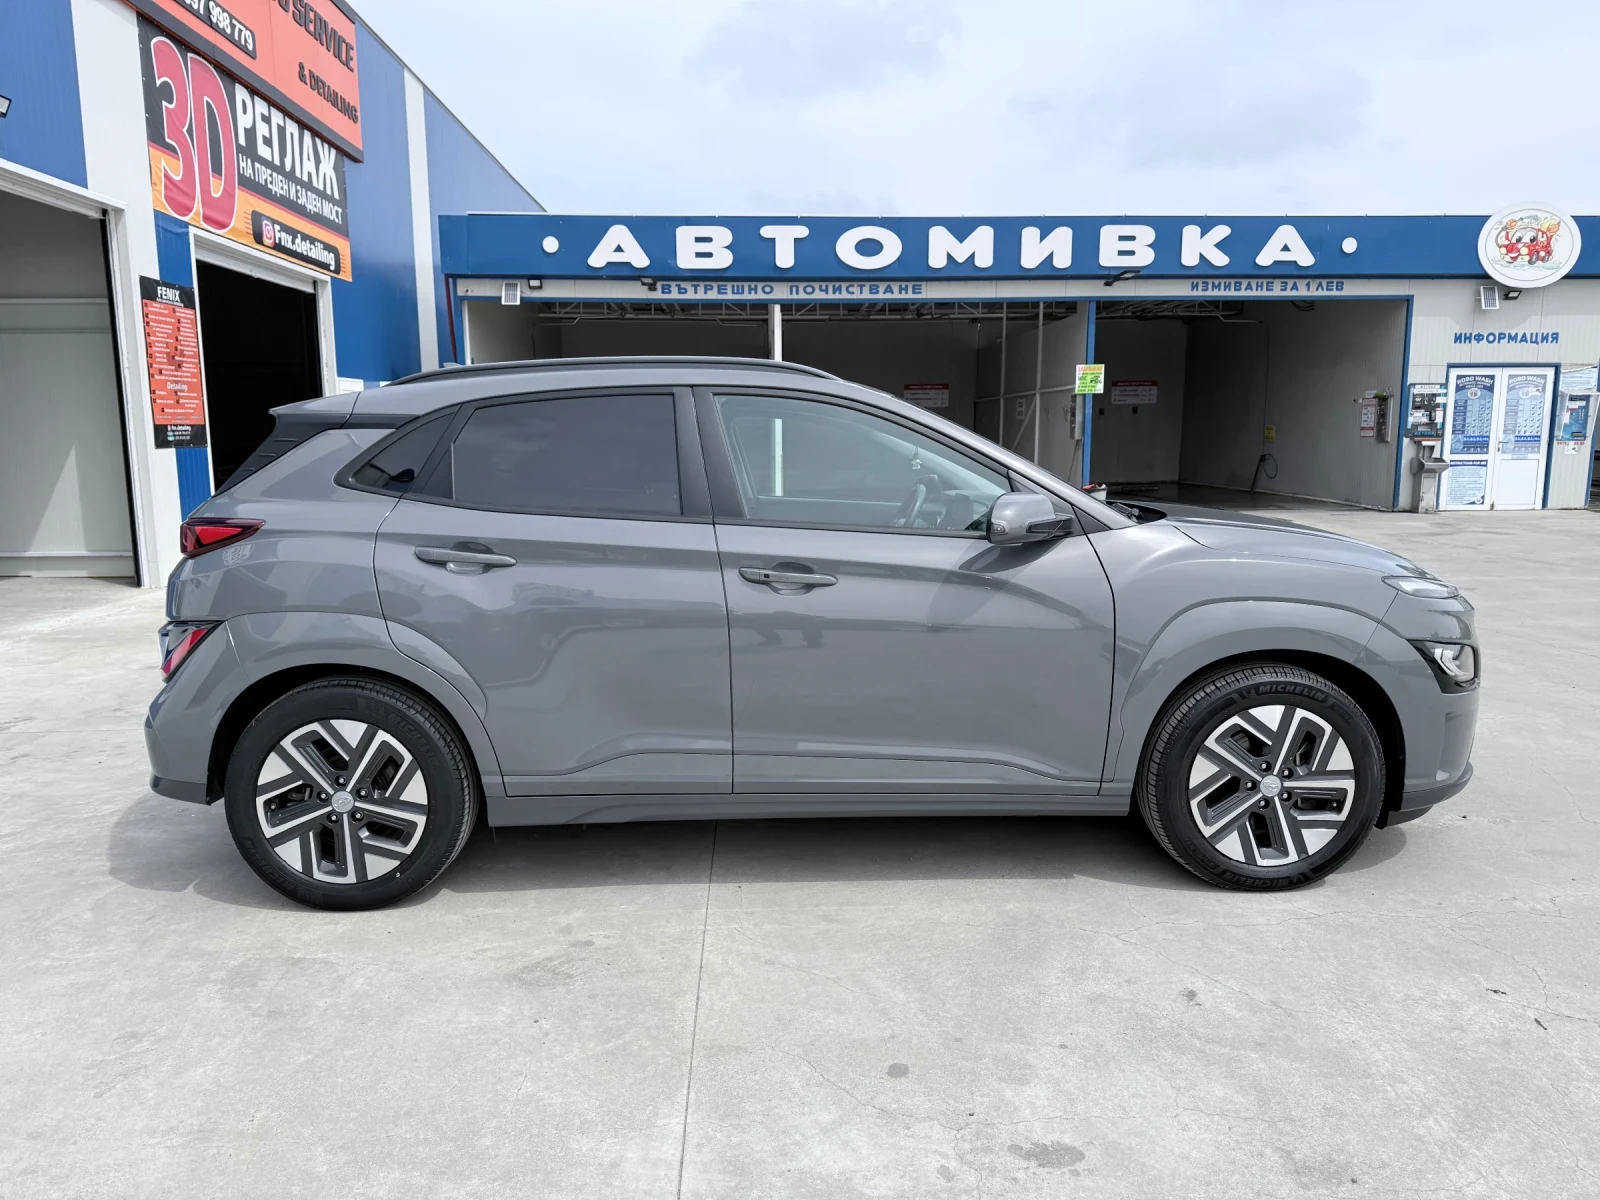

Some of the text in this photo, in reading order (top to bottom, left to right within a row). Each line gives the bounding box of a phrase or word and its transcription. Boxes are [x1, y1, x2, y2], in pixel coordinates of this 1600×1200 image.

[208, 1, 231, 34] 998
[232, 19, 253, 51] 779
[292, 0, 354, 72] SERVICE
[298, 62, 359, 124] & DETAILING
[150, 36, 238, 235] 3D
[235, 82, 341, 200] РЕГЛАЖ
[239, 153, 343, 225] НА ПРЕДЕН И ЗАДЕН МОСТ
[274, 222, 336, 271] Fnx.detailing
[587, 223, 1316, 270] АВТОМИВКА
[157, 286, 180, 302] FENIX
[660, 282, 923, 296] ВЪТРЕШНО ПОЧИСТВАНЕ
[1191, 280, 1345, 292] ИЗМИВАНЕ ЗА 1 ЛЕВ
[1453, 332, 1560, 345] ИНФОРМАЦИЯ
[167, 381, 188, 392] Detailing
[1475, 375, 1494, 385] WASH
[1527, 375, 1546, 384] WASH
[1258, 684, 1326, 701] MICHELIN
